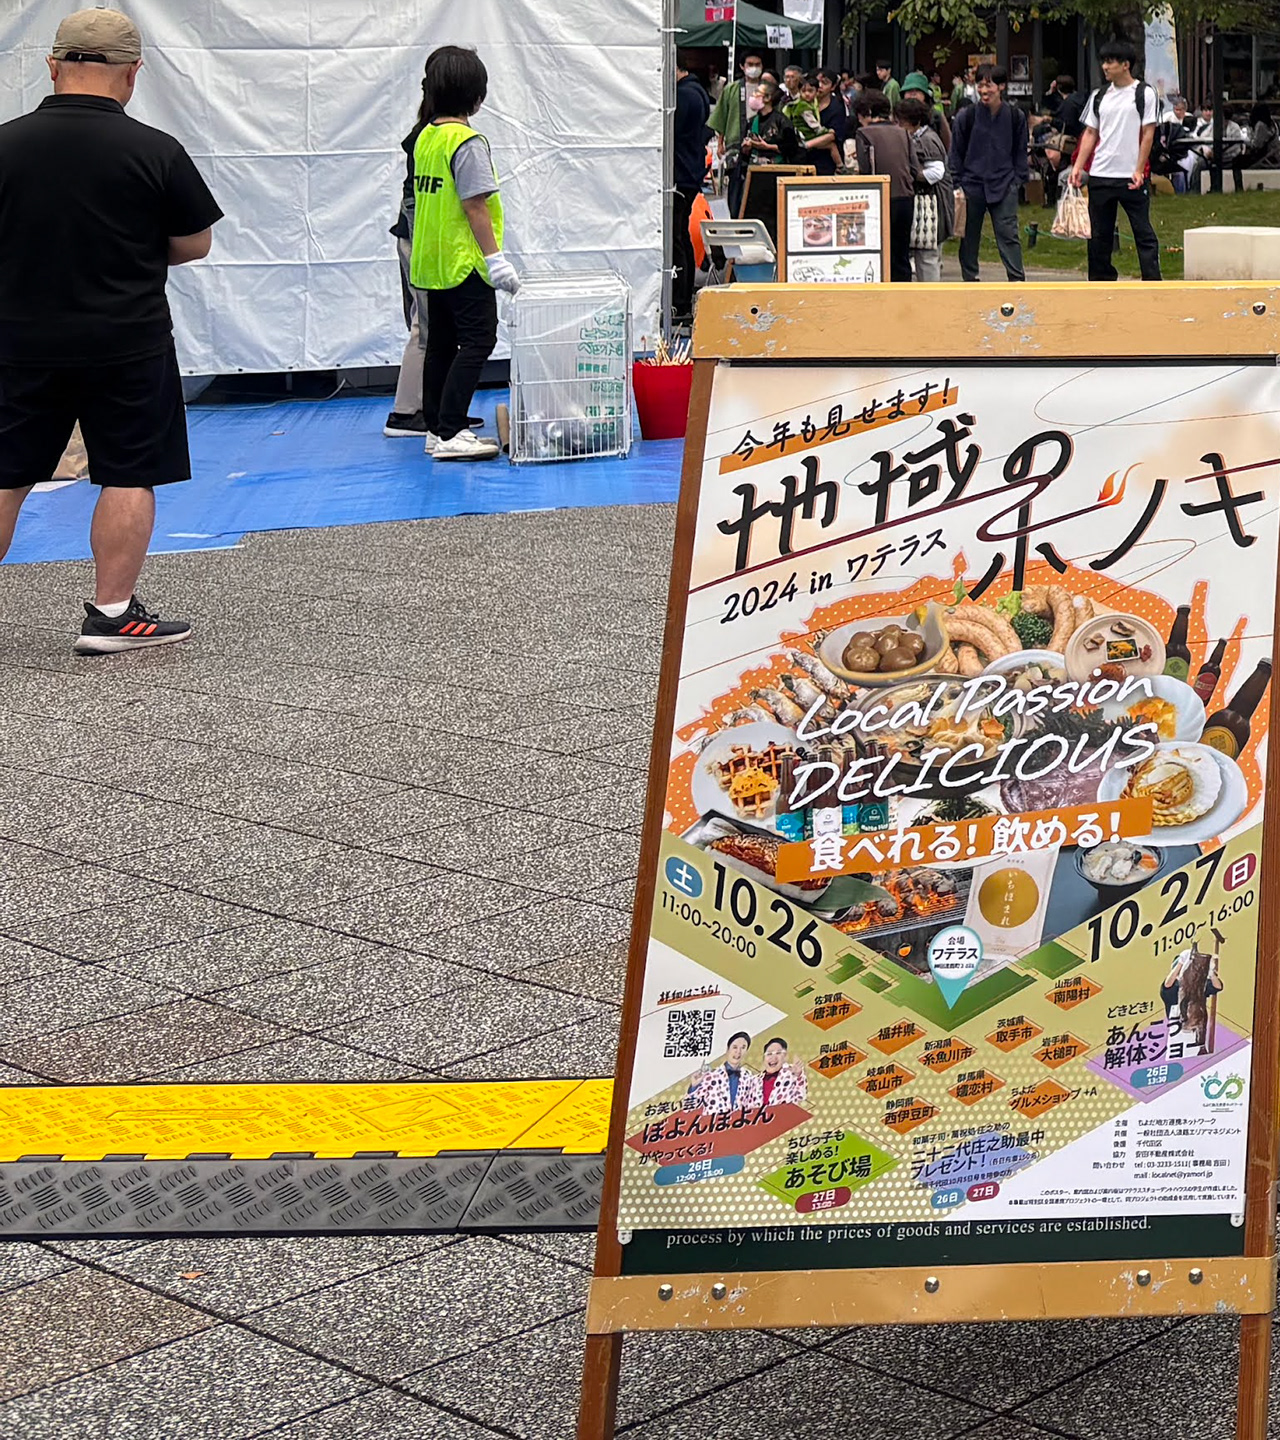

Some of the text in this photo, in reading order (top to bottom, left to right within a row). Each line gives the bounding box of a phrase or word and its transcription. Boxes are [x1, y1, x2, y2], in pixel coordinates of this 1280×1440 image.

[731, 378, 950, 461] 今年も見せます！
[720, 529, 946, 624] 2024 in ワテラス
[796, 669, 1153, 741] Local Passion
[788, 723, 1159, 810] DELICIOUS
[674, 864, 692, 893] 土
[1231, 860, 1250, 887] 日
[1000, 870, 1017, 926] いちほまれ
[1087, 846, 1226, 963] 10.27
[714, 861, 822, 967] 10.26
[948, 936, 965, 945] 会場
[933, 948, 978, 960] ワテラス
[1055, 977, 1082, 988] 山形県
[814, 992, 842, 1005] 佐賀県
[813, 1003, 850, 1020] 唐津市
[997, 1016, 1024, 1028] 茨城県
[878, 1023, 915, 1040] 福井県
[996, 1027, 1033, 1042] 取手市
[1106, 1016, 1184, 1046] あんこう
[820, 1041, 848, 1054] 岡山県
[924, 1038, 952, 1051] 新潟県
[1042, 1035, 1069, 1047] 岩手県
[819, 1052, 856, 1069] 倉敷市
[923, 1047, 972, 1065] 糸魚川市
[1104, 1042, 1205, 1070] 解体ショー
[866, 1064, 895, 1077] 岐阜県
[957, 1070, 985, 1082] 群馬県
[1147, 1065, 1168, 1077] 26日
[866, 1075, 903, 1092] 高山市
[1011, 1085, 1036, 1097] ちよだ
[645, 1093, 709, 1117] お笑い芸人
[886, 1097, 914, 1109] 静岡県
[1010, 1088, 1097, 1110] グルメショップ +A
[885, 1106, 934, 1125] 西伊豆町
[788, 1130, 845, 1149] ちびっ子も
[1113, 1150, 1194, 1159] 協力 安田不動産株式会社
[688, 1159, 712, 1172] 26日
[784, 1155, 871, 1189] あそび場
[812, 1190, 835, 1202] 27日
[937, 1192, 958, 1205] 26日
[973, 1186, 994, 1198] 27日
[667, 1216, 1151, 1248] process by which the prices of goods and services are established.
